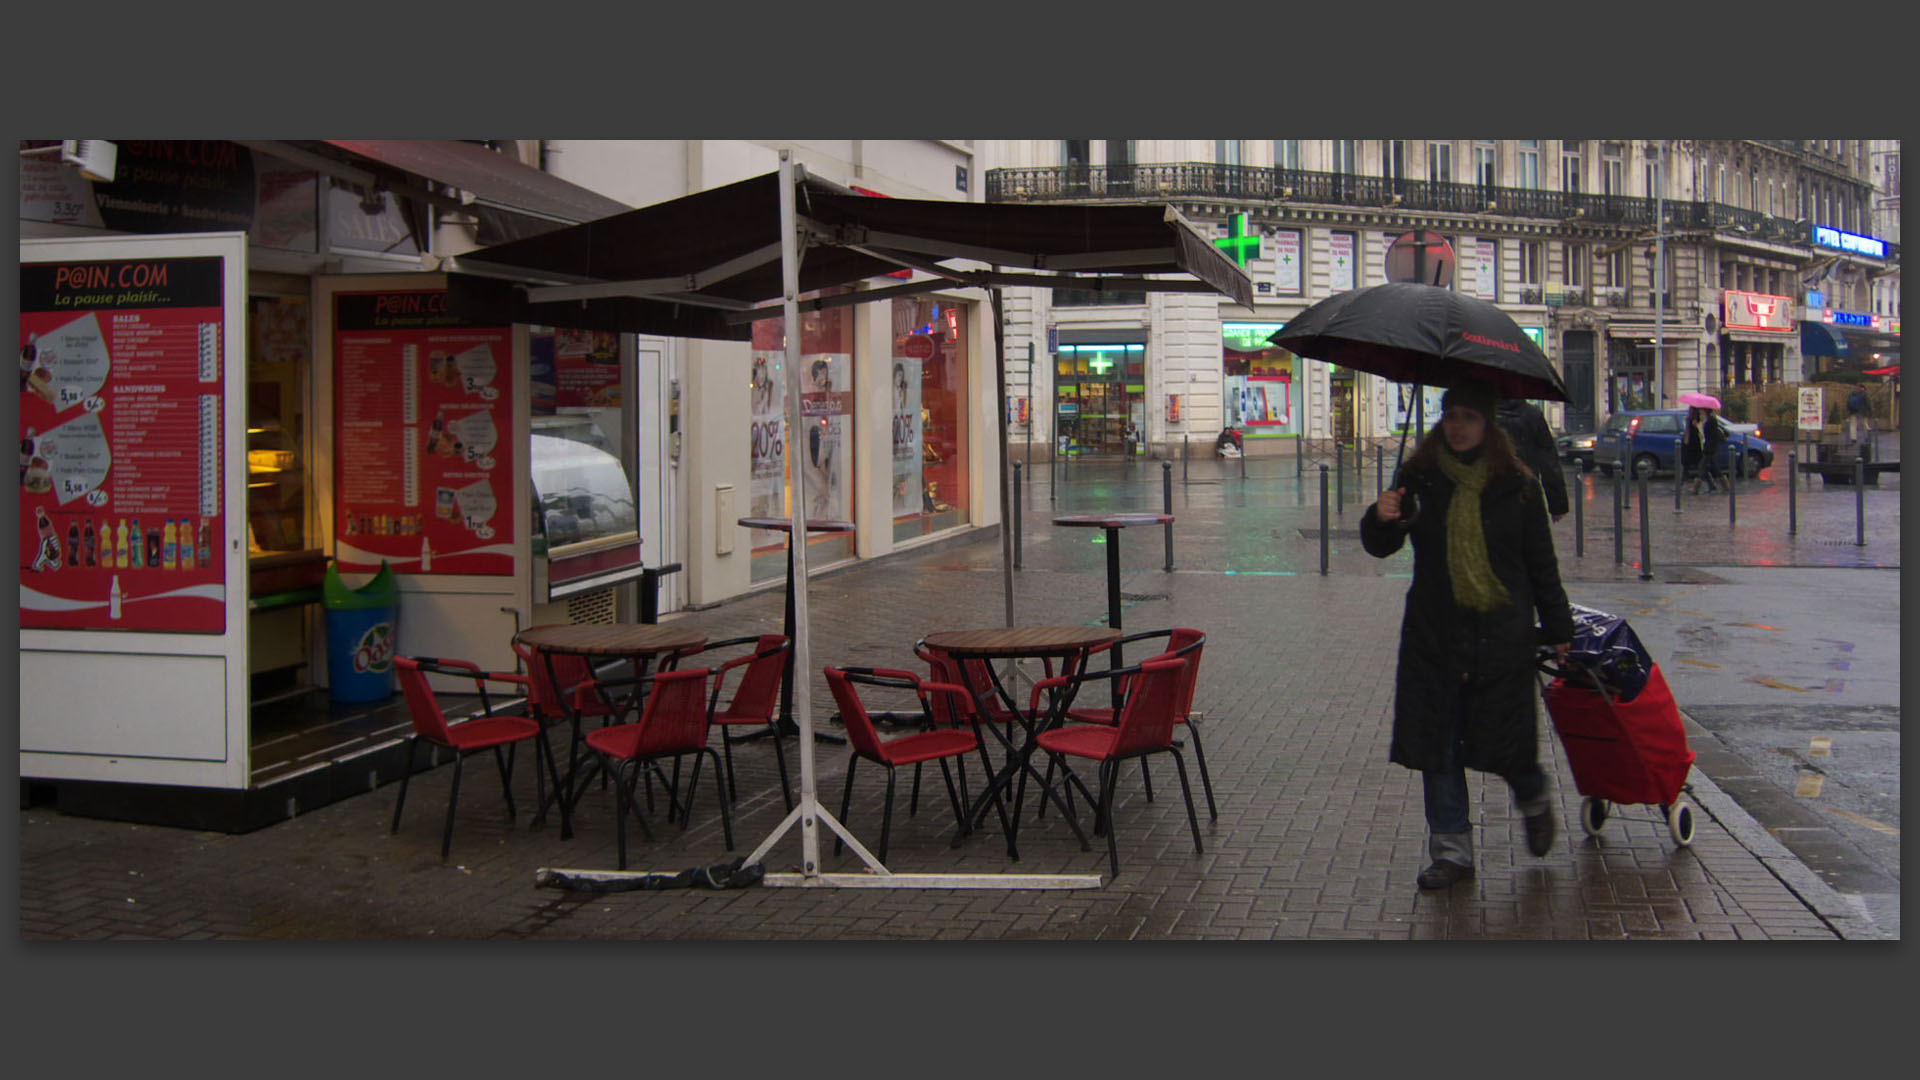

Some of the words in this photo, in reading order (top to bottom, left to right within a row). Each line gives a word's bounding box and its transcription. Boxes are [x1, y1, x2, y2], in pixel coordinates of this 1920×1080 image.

[55, 263, 168, 289] P@IN.COM
[54, 292, 71, 306] La
[73, 292, 114, 307] pause
